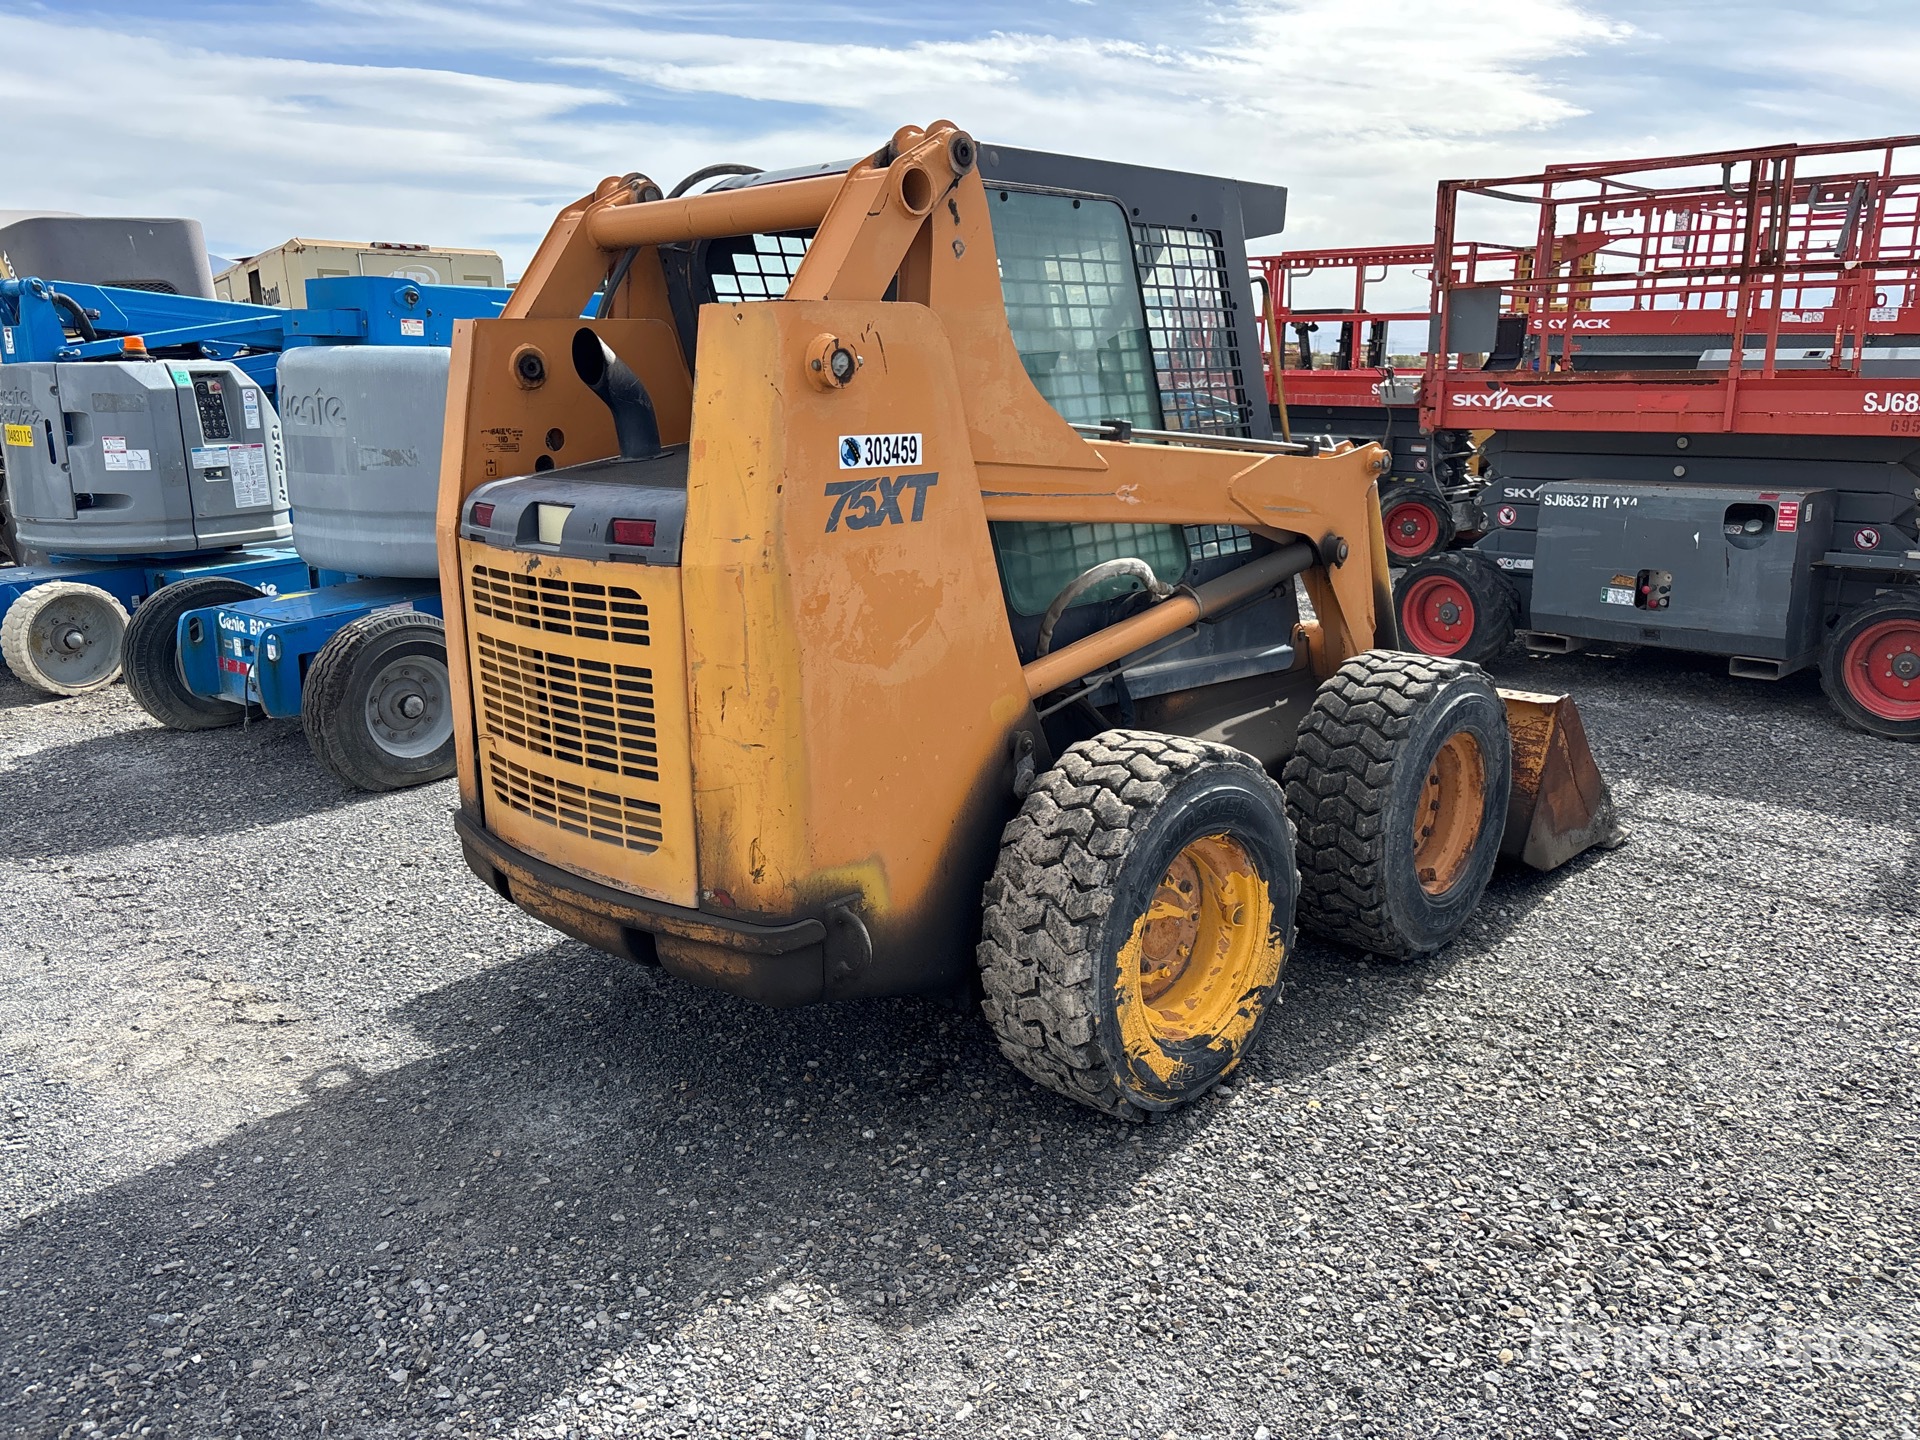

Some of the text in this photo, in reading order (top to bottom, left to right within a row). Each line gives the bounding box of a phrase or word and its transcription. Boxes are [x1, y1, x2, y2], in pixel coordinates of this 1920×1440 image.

[1533, 314, 1611, 331] SKYACK
[1452, 387, 1554, 410] SKYJACK
[1863, 392, 1920, 413] SJ68
[865, 435, 917, 466] 303459
[824, 472, 939, 533] 75XT
[1592, 496, 1609, 509] RT
[218, 612, 247, 633] Genie
